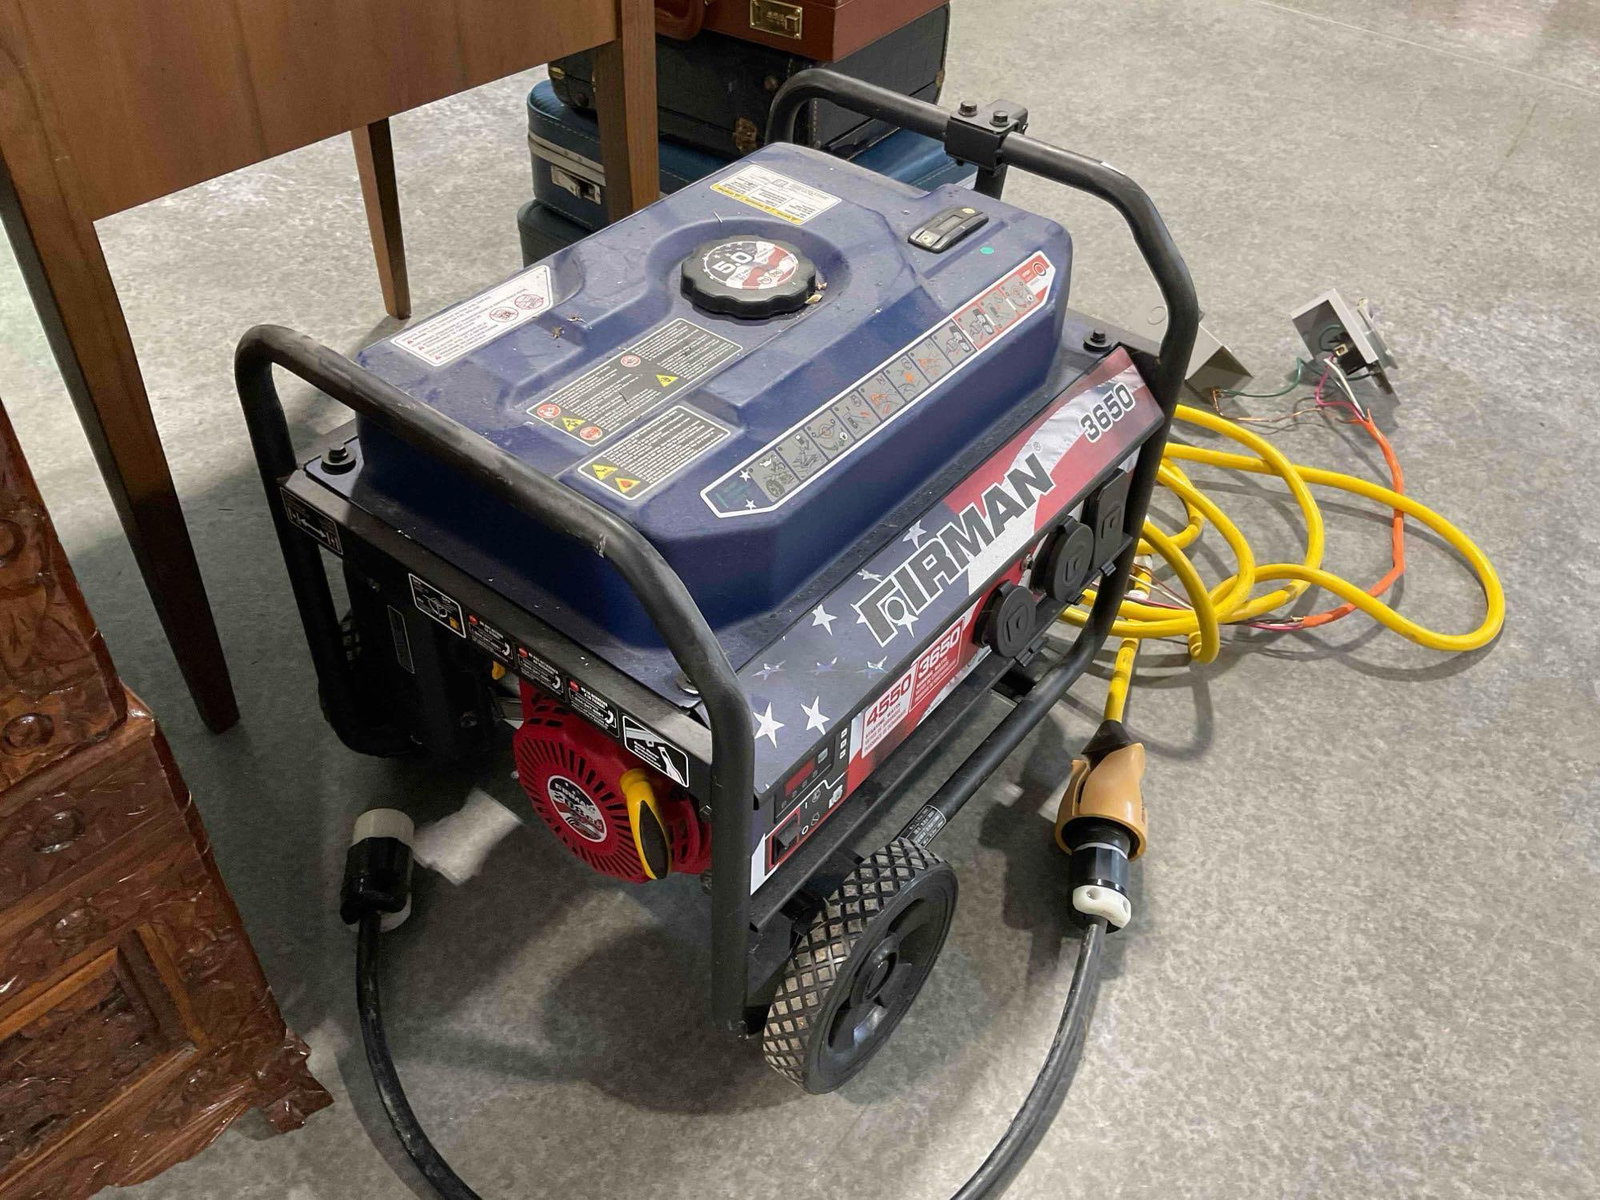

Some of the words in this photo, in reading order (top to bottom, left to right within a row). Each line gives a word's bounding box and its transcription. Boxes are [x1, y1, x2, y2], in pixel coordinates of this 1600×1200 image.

[712, 251, 754, 274] 5.0
[1081, 382, 1136, 442] 3650
[918, 625, 961, 679] 3650
[867, 673, 912, 727] 4550
